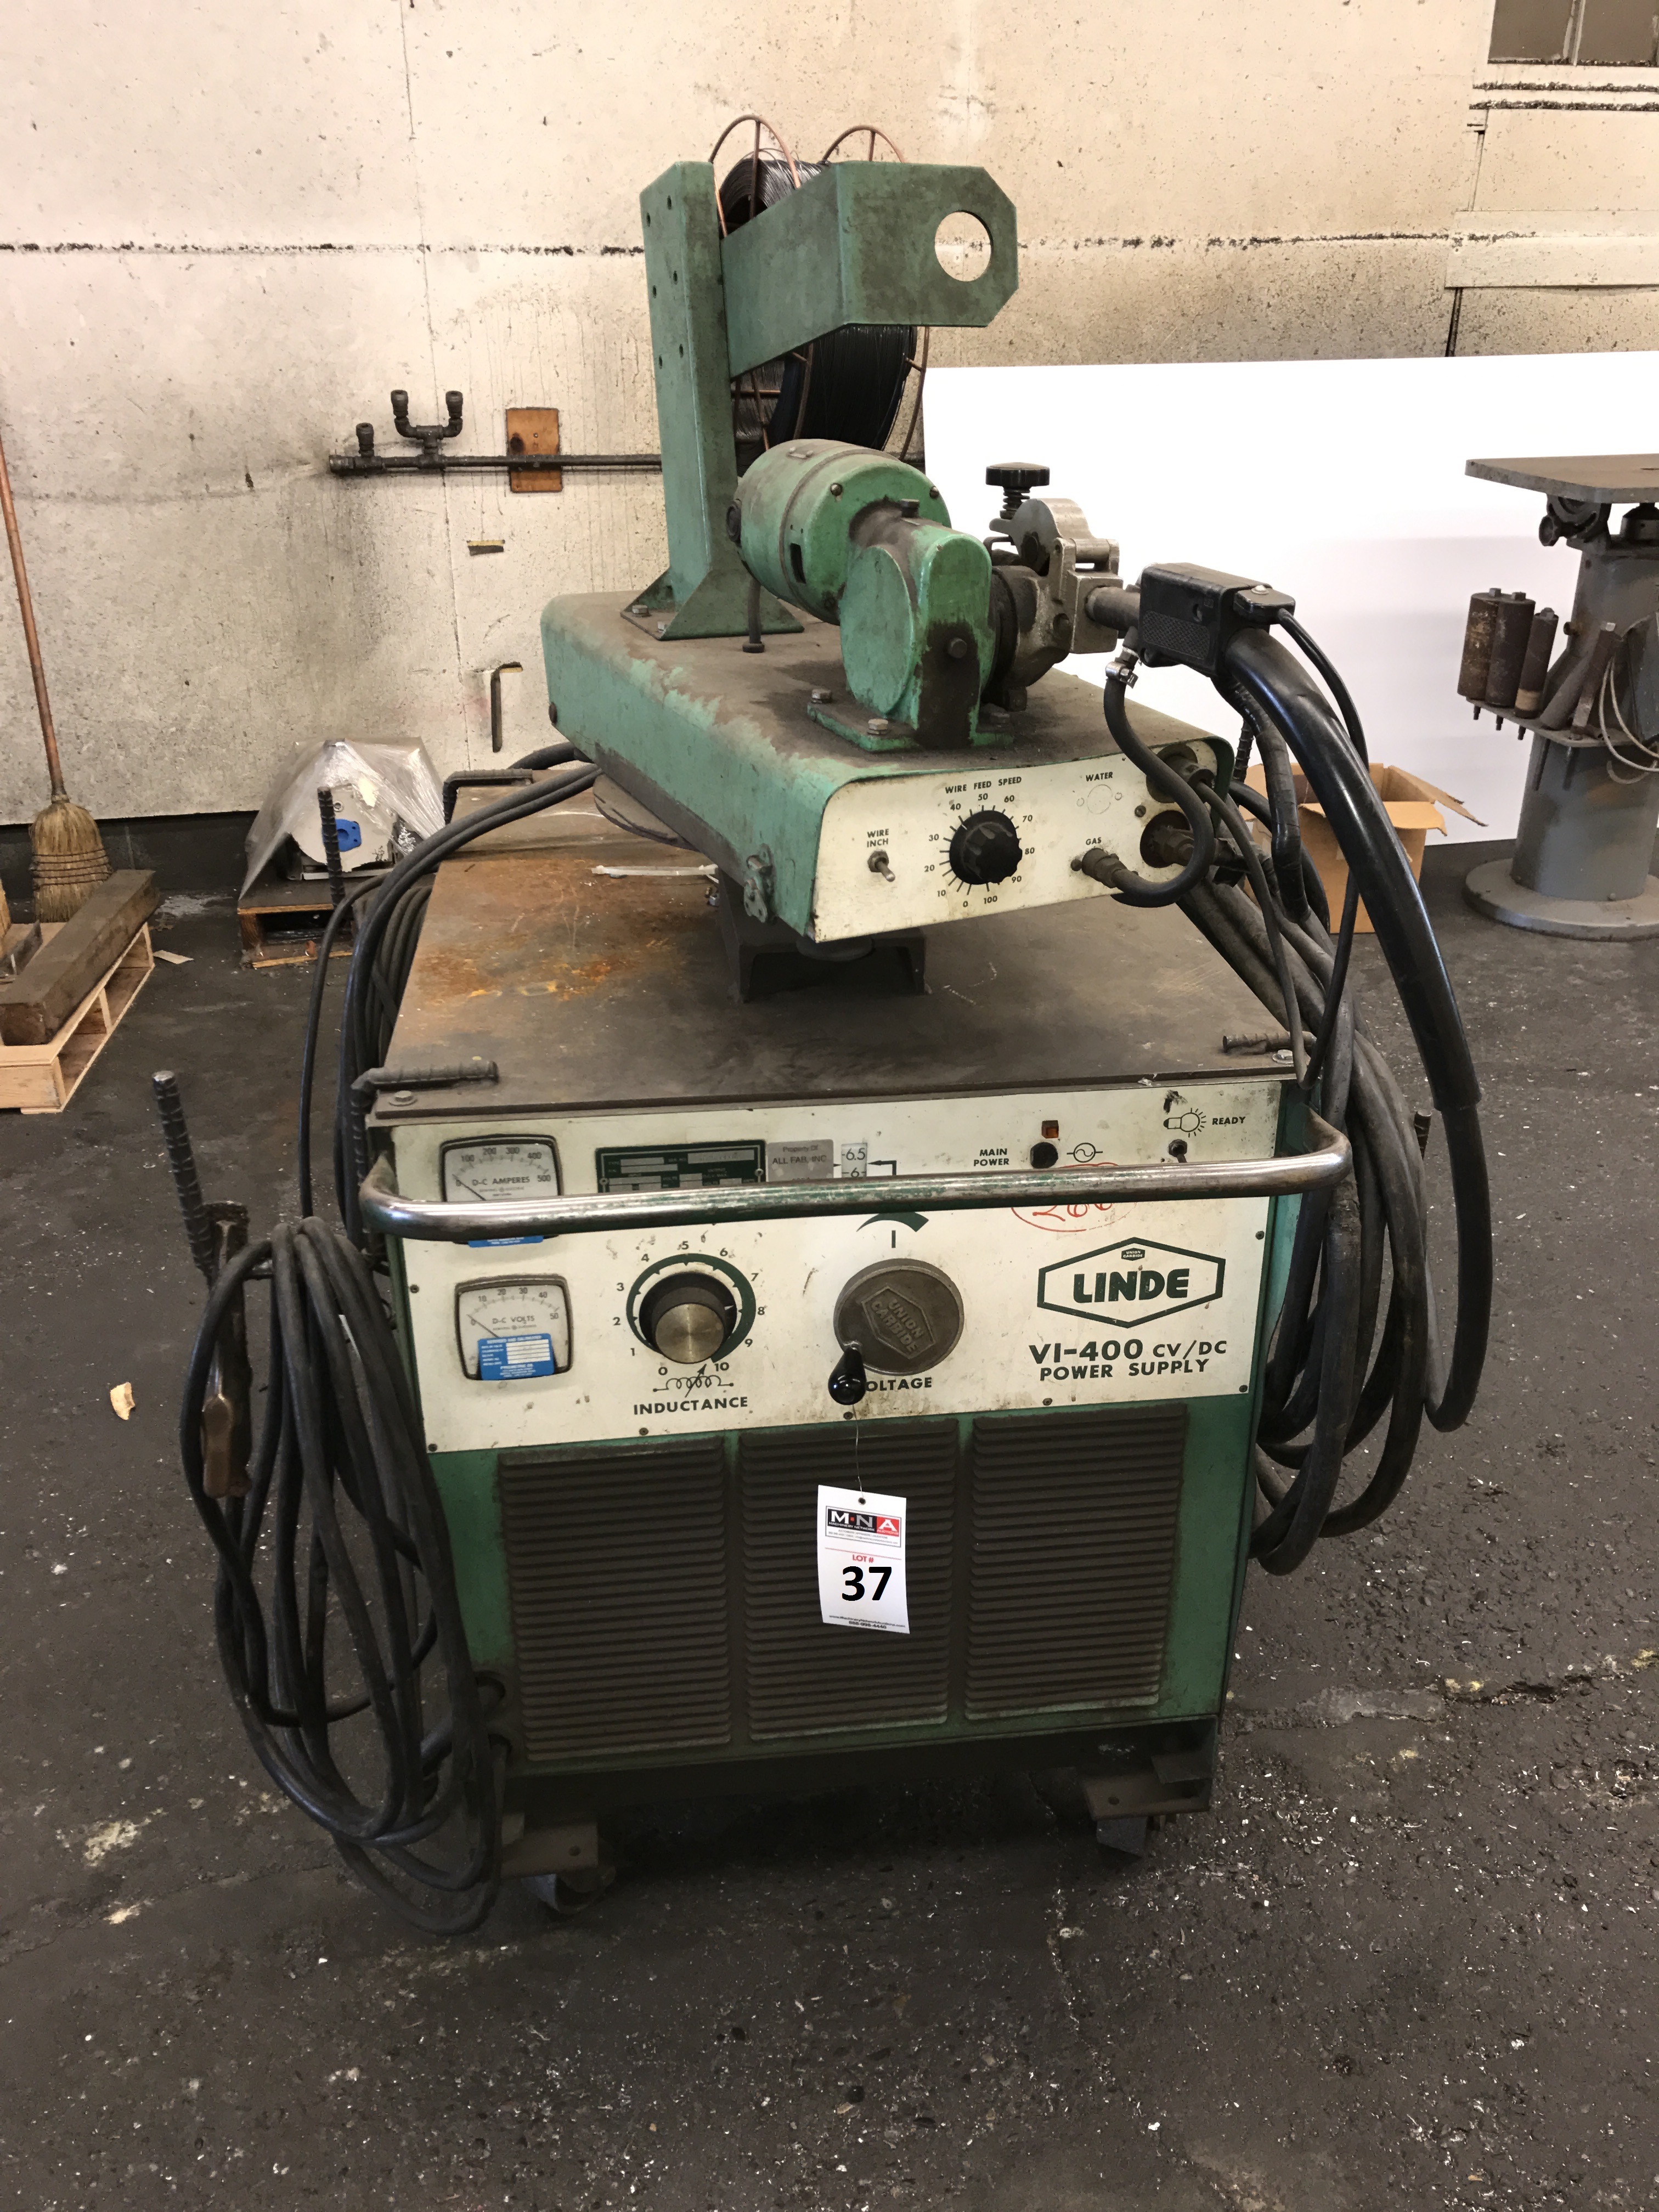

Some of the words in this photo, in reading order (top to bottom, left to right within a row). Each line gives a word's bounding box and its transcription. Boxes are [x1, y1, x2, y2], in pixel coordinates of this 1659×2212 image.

[1086, 771, 1113, 782] WATER
[945, 785, 967, 794] WIRE
[973, 781, 992, 790] FEED
[998, 776, 1022, 786] SPEED
[867, 829, 889, 838] WIRE
[867, 838, 889, 848] INCH
[1086, 837, 1102, 845] GAS
[924, 864, 935, 872] 20
[983, 895, 998, 904] 100
[1212, 1116, 1246, 1126] READY
[979, 1148, 1008, 1156] MAIN
[973, 1158, 1009, 1166] POWER
[851, 1167, 860, 1177] 6
[492, 1176, 530, 1184] AMPERES
[681, 1241, 689, 1250] 5
[720, 1248, 729, 1256] 6
[641, 1253, 650, 1262] 4
[751, 1273, 759, 1282] 7
[616, 1282, 624, 1291] 3
[1073, 1268, 1189, 1304] LINDE
[758, 1306, 765, 1316] 8
[613, 1317, 620, 1326] 2
[889, 1299, 924, 1339] UNION
[871, 1301, 917, 1352] CARBIDE
[744, 1339, 753, 1347] 9
[631, 1348, 635, 1356] 1
[1029, 1339, 1143, 1364] VI-400
[1153, 1340, 1227, 1359] CV/DC
[658, 1367, 668, 1375] 0
[714, 1362, 730, 1371] 10
[1040, 1364, 1113, 1381] POWER
[1128, 1359, 1209, 1376] SUPPLY
[866, 1377, 932, 1392] OLTAGE
[634, 1396, 748, 1415] INDUCTANCE
[852, 1554, 867, 1562] LOT
[842, 1566, 892, 1601] 37
